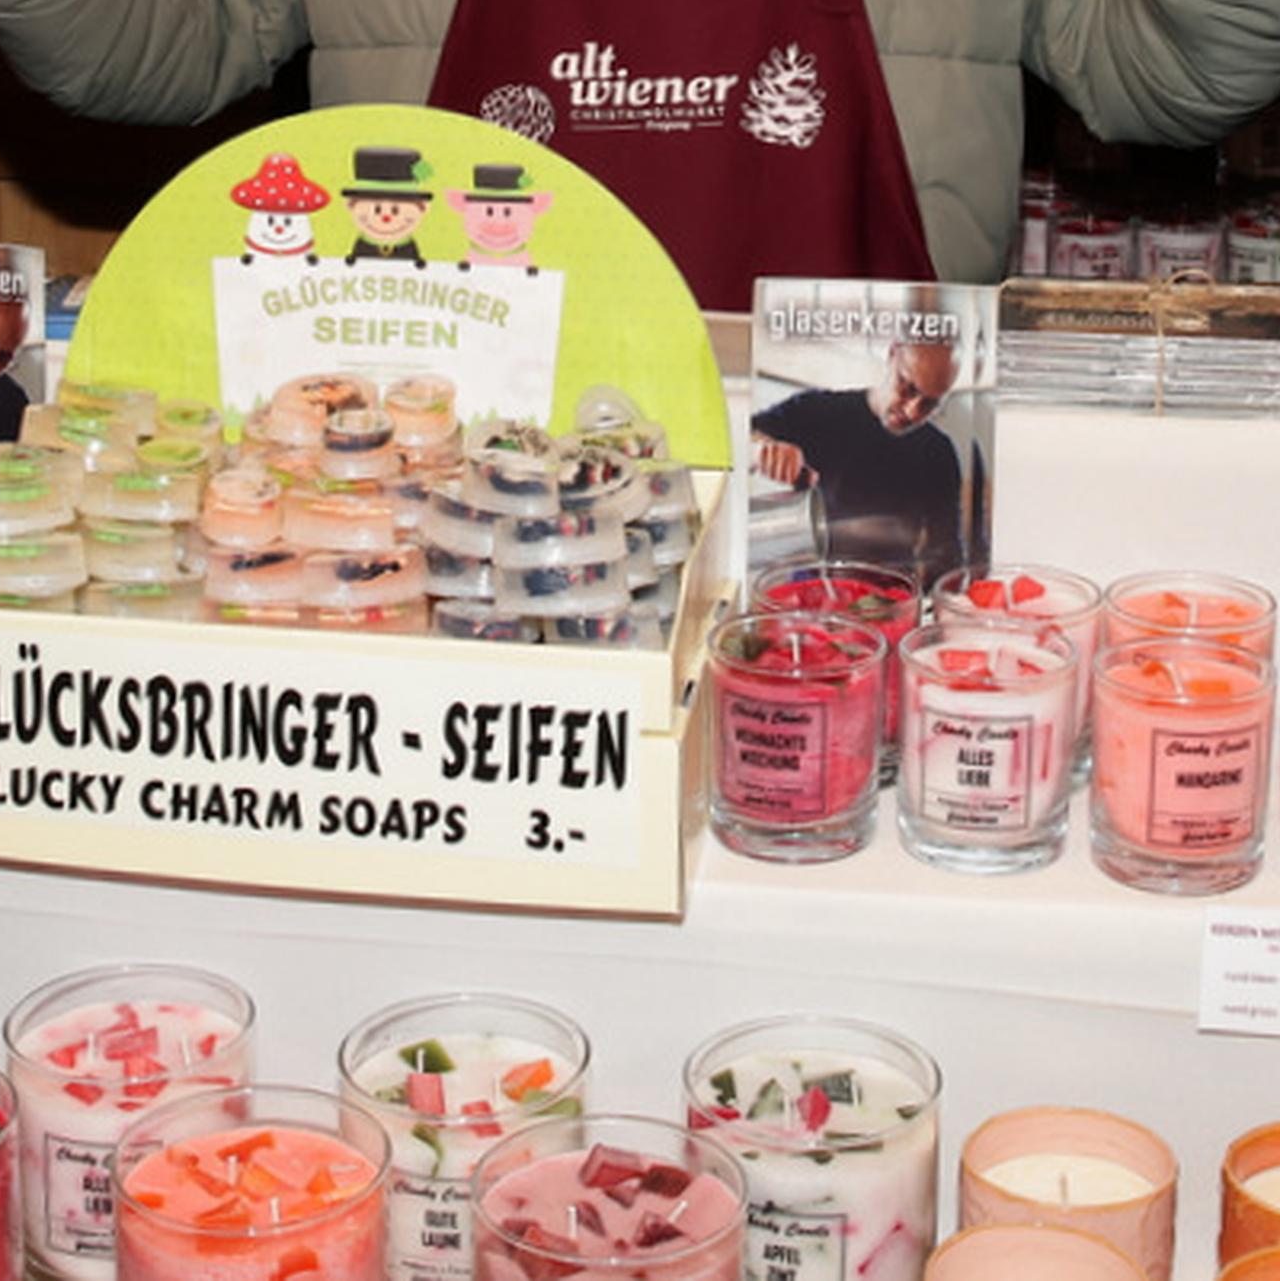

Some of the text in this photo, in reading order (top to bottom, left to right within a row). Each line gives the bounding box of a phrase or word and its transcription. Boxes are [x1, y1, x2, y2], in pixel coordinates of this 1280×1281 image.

[550, 42, 617, 80] alt
[570, 71, 738, 106] wiener
[262, 274, 511, 328] GLÜCKSBRINGER
[312, 316, 459, 349] SEIFEN
[771, 300, 959, 339] glaserkerzen
[441, 700, 629, 791] SEIFEN
[957, 748, 995, 766] ALLES
[140, 779, 303, 831] CHARM
[319, 796, 466, 844] SOAPS
[1211, 924, 1259, 938] KERZEN
[421, 1231, 462, 1250] LAUNE
